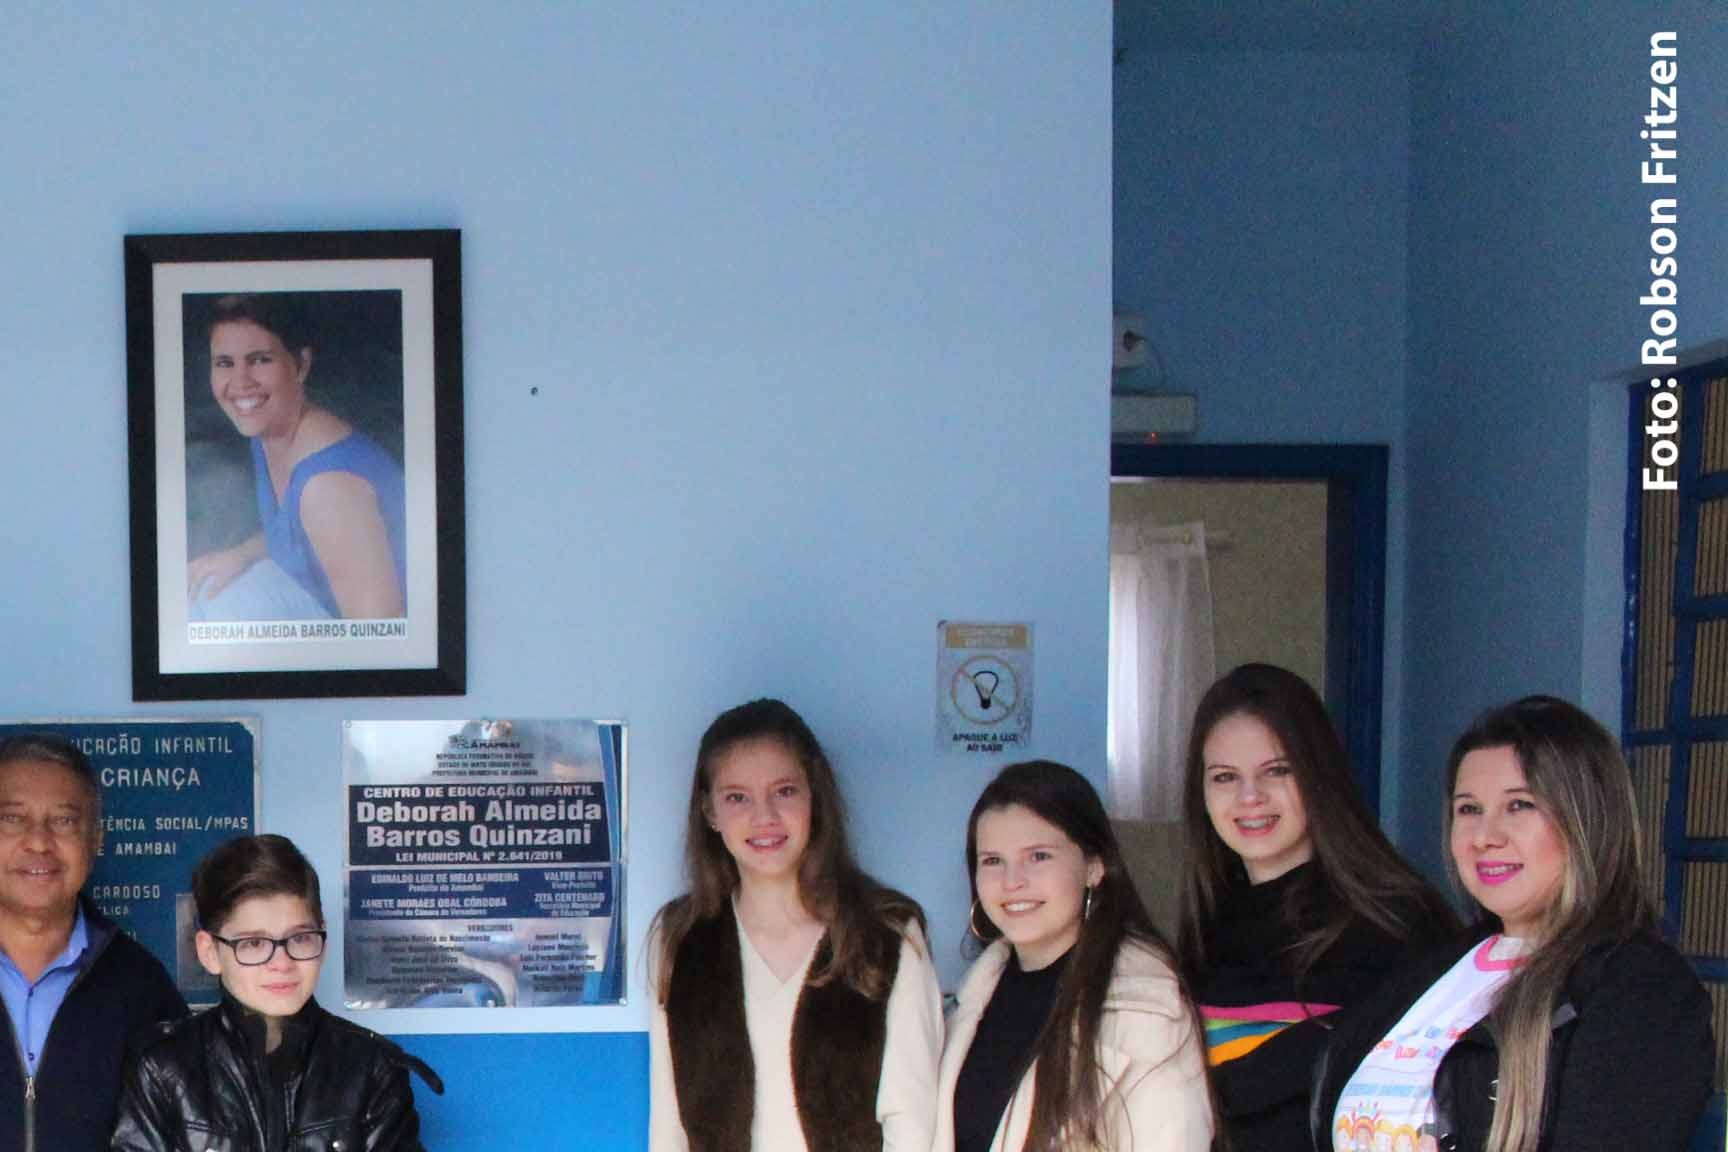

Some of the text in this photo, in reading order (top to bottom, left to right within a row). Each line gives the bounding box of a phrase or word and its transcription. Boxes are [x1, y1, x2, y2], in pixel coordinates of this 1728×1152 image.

[189, 622, 407, 641] DEBORAH ALMEIDA BARROS QUINZANI
[154, 736, 234, 756] INFANTIL
[100, 766, 202, 791] CRIANÇA
[363, 783, 595, 800] CENTRO DE EDUCAÇÃO INFANTIL
[356, 798, 603, 824] Deborah Almeida
[366, 822, 593, 849] Barros Quinzani
[114, 840, 178, 857] AMAMBAI
[395, 852, 414, 863] LEI
[92, 884, 161, 900] CARDOSO
